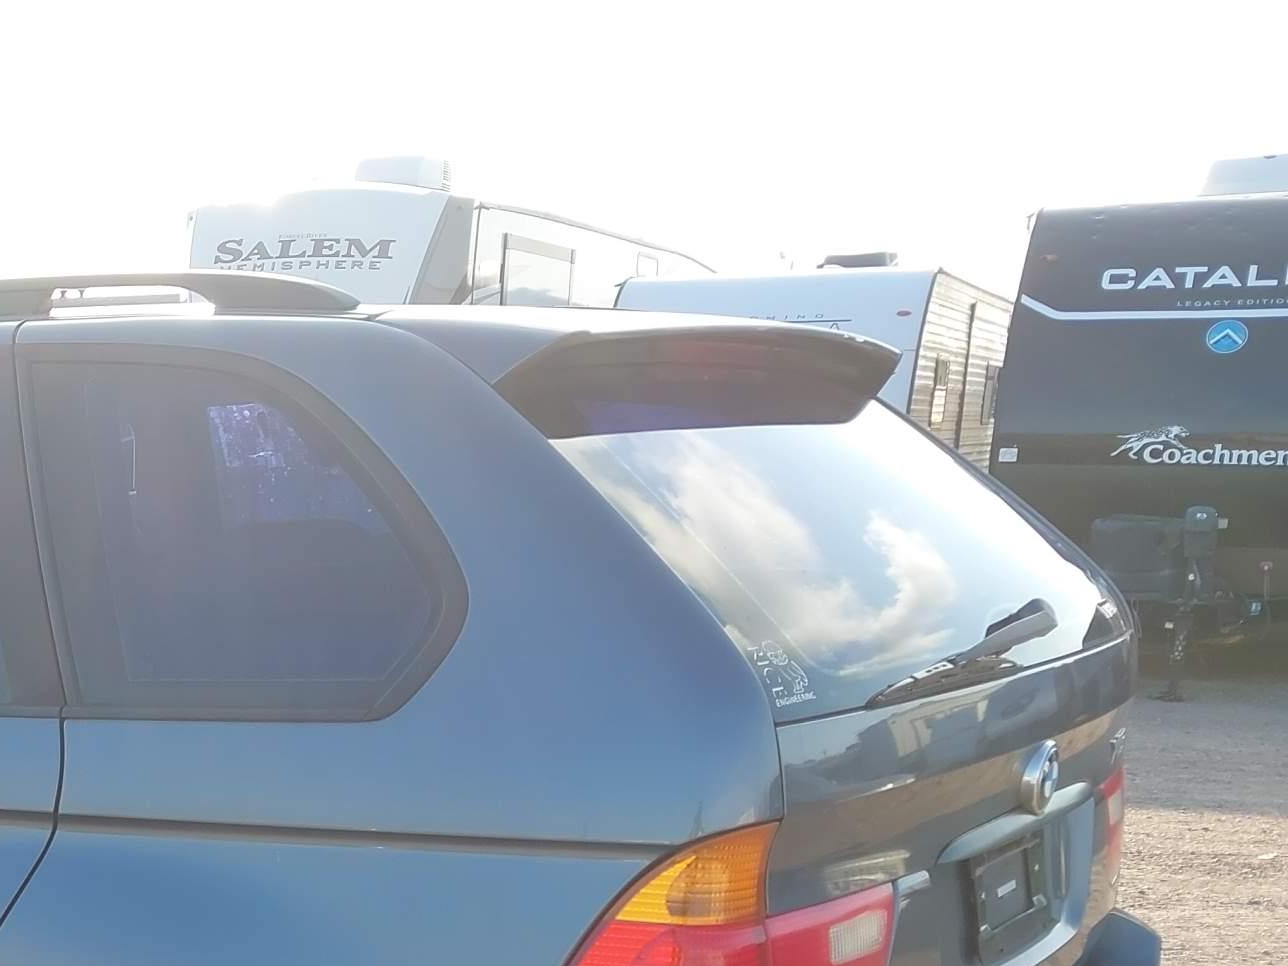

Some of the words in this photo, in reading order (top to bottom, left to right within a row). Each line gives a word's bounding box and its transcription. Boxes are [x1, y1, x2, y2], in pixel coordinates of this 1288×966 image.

[213, 238, 396, 265] SALEM
[1176, 299, 1231, 307] LEGACY
[1238, 297, 1288, 305] EDITIO
